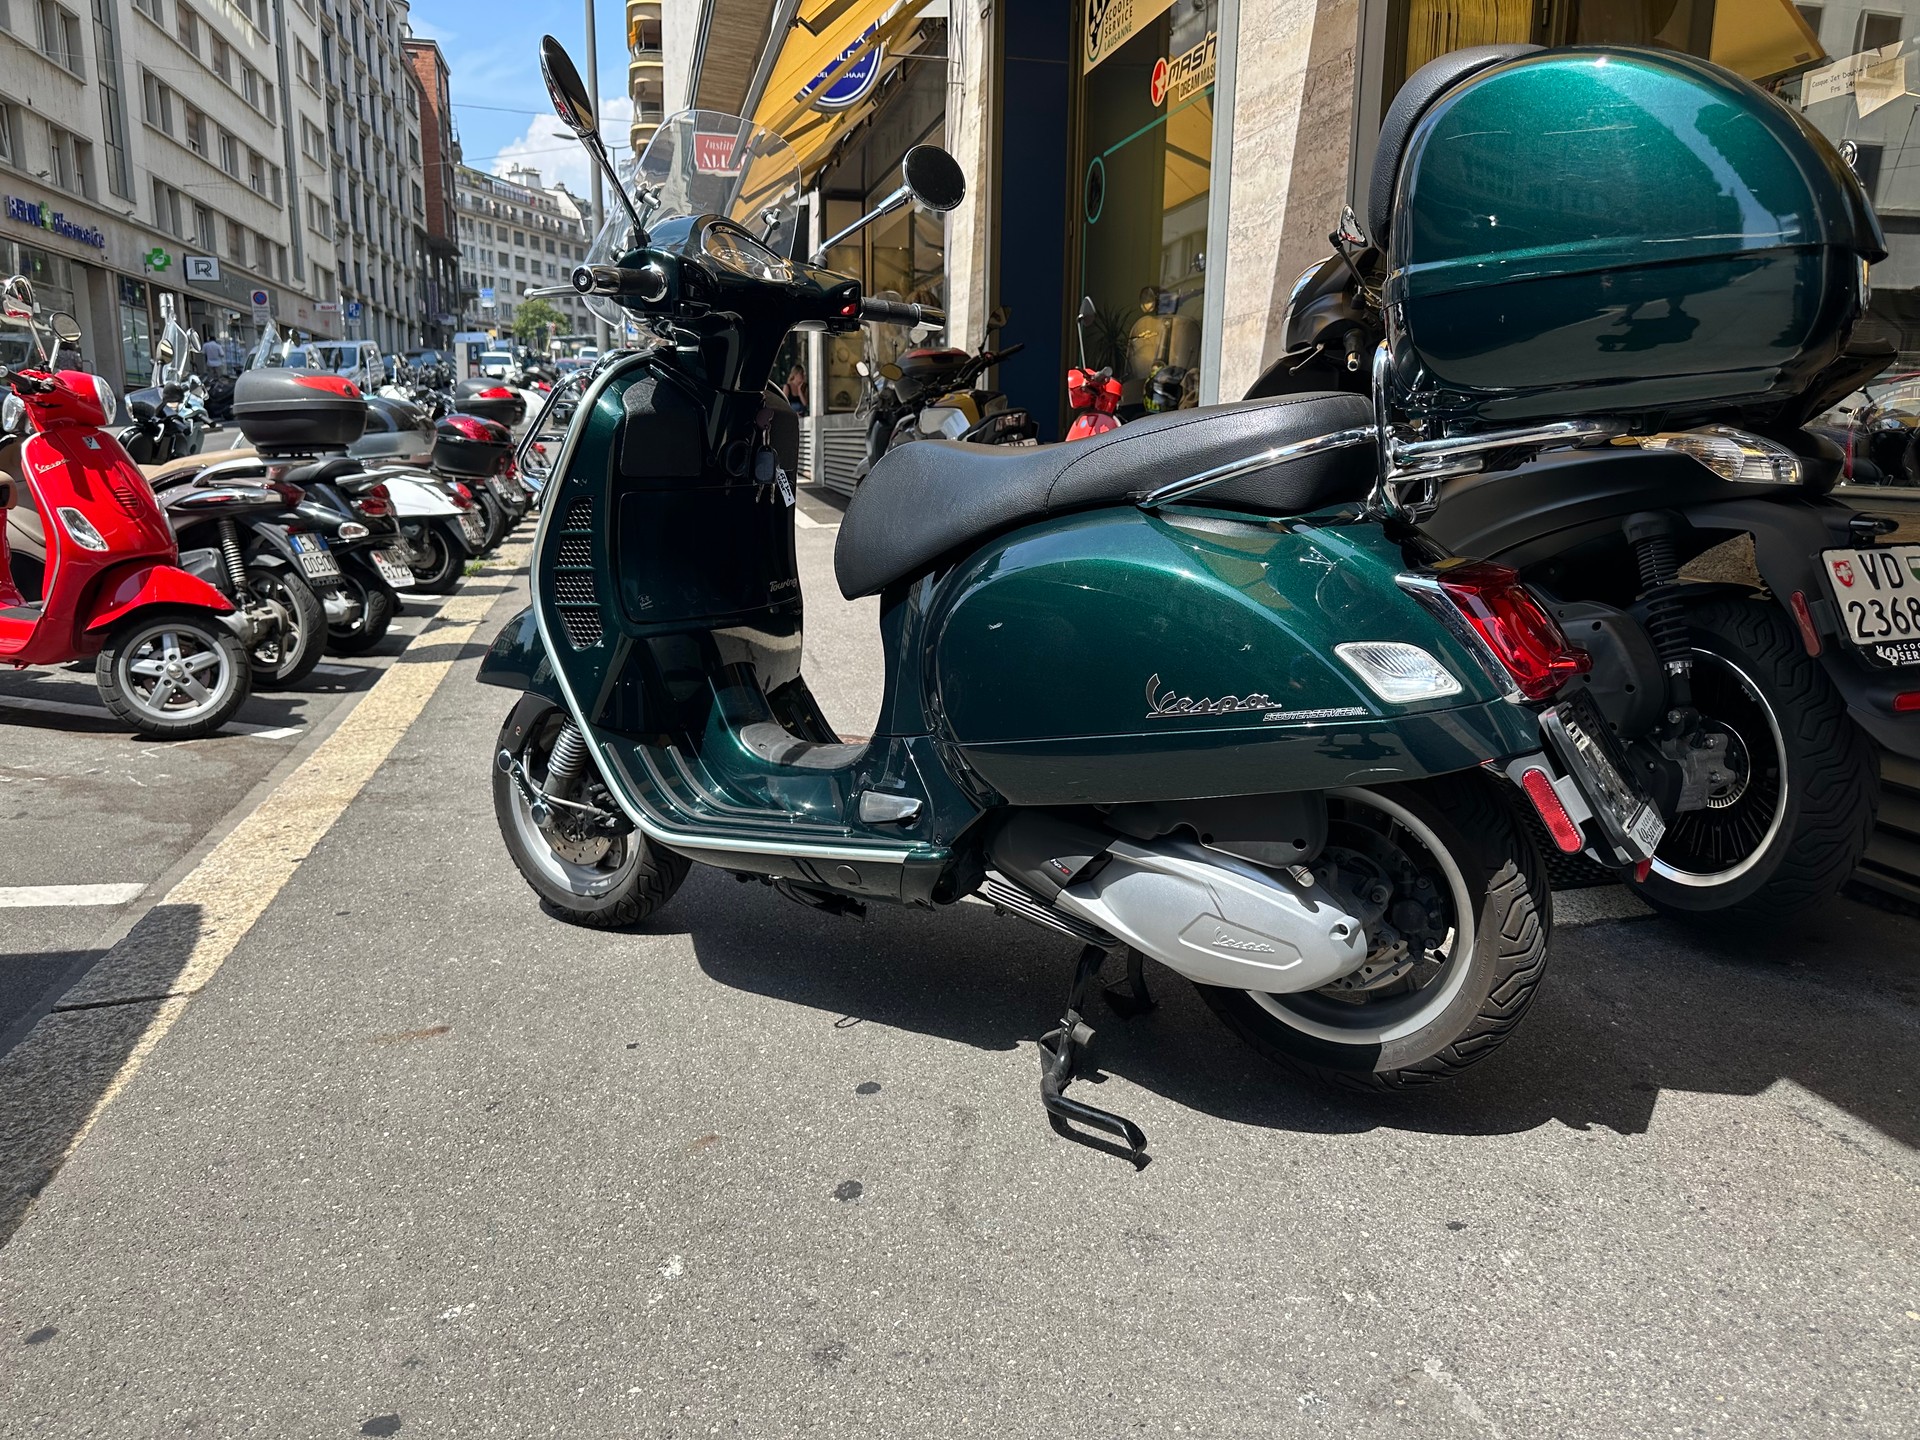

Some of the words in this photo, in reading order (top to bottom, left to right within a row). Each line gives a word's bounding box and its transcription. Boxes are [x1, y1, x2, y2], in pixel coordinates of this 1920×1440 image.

[1105, 0, 1132, 24] SCOOT
[1105, 6, 1132, 38] SERVICE
[1104, 21, 1132, 51] LAUSANNE
[1180, 73, 1200, 97] DREAM
[194, 259, 212, 277] R
[769, 577, 798, 593] Touring
[1858, 552, 1905, 590] VD
[1146, 673, 1283, 719] Vespa
[1211, 925, 1275, 953] Vespa
